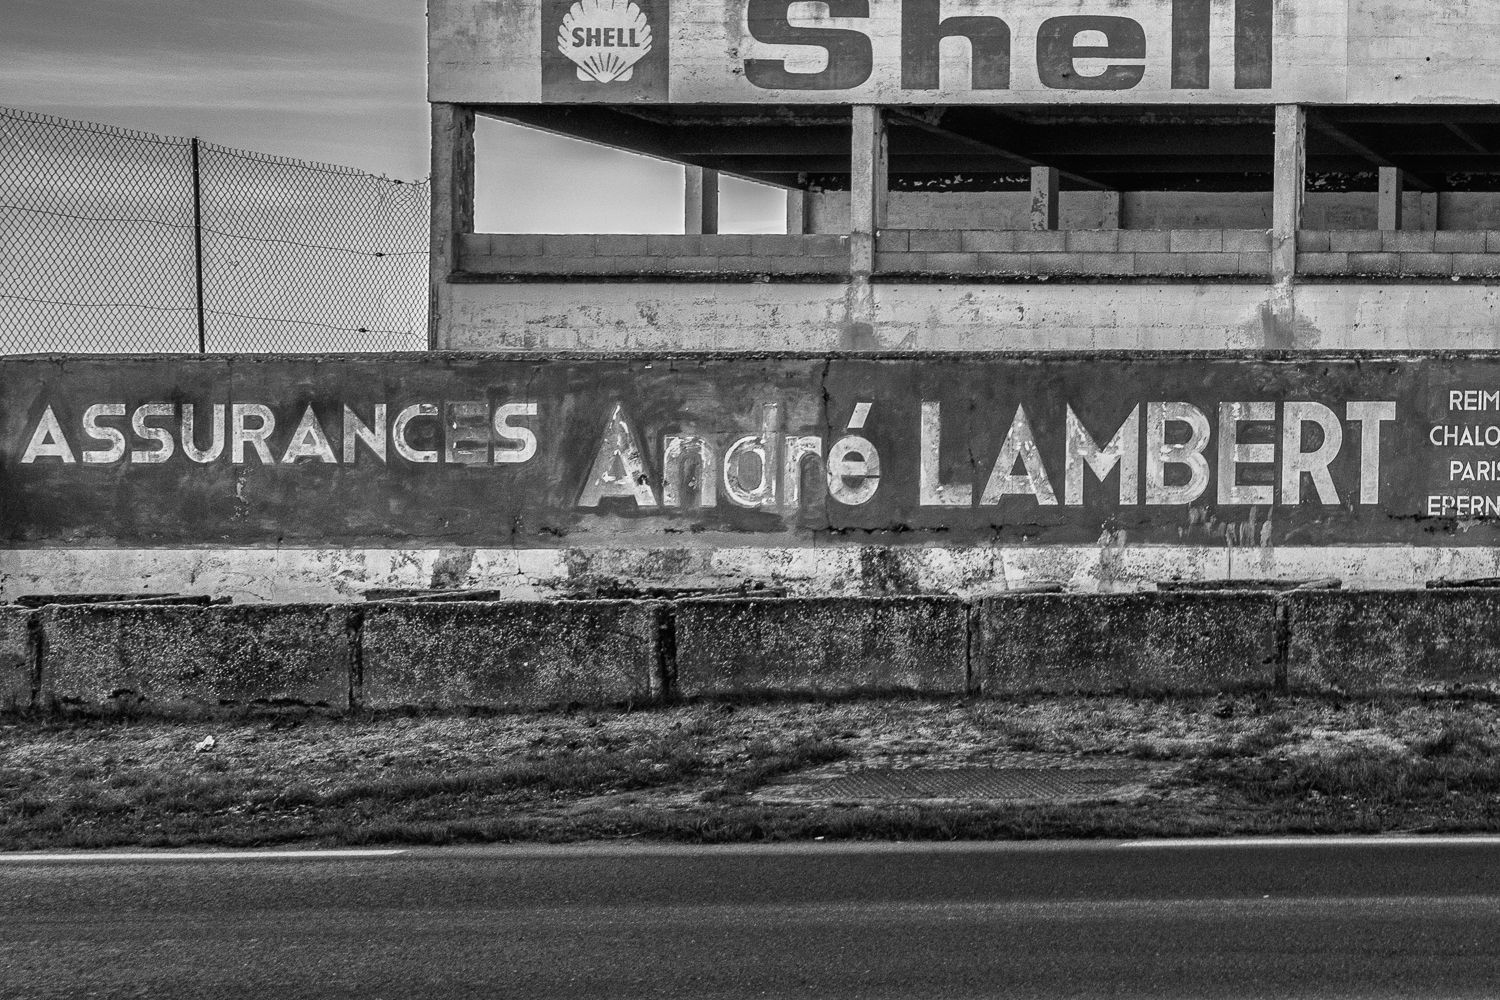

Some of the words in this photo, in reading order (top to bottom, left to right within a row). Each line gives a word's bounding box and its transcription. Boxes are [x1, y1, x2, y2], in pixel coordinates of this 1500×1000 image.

[572, 27, 640, 48] SHELL
[20, 402, 538, 464] ASSURANCES
[577, 402, 881, 507] André
[919, 401, 1396, 505] LAMBERT
